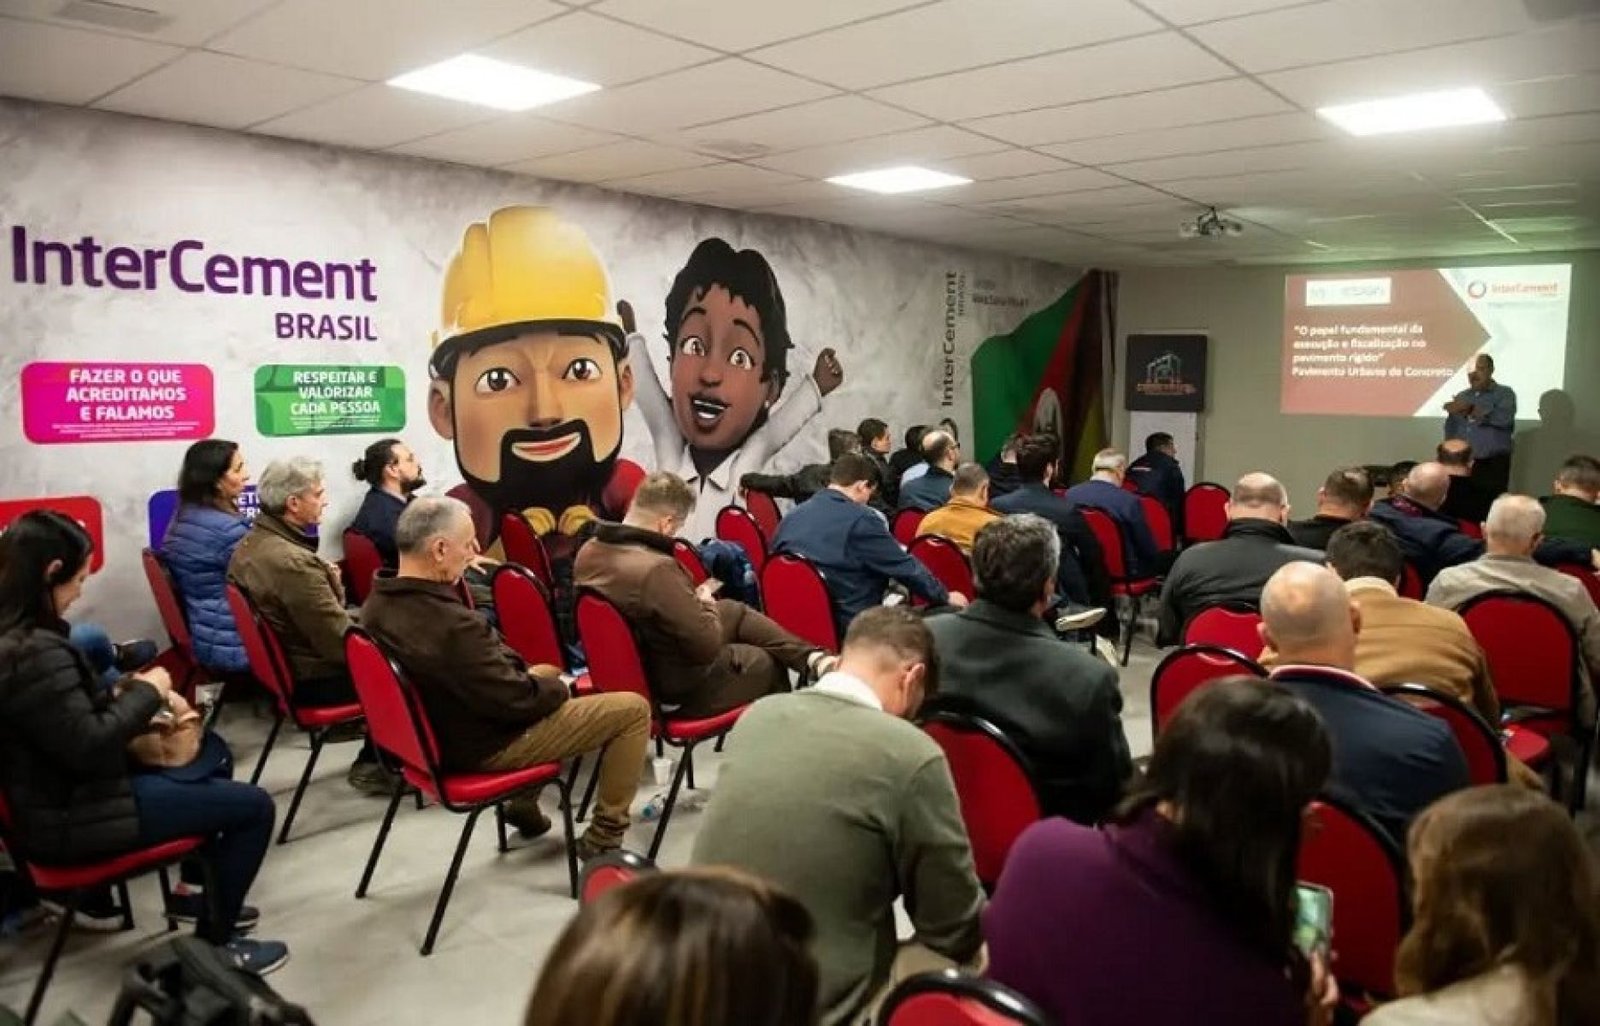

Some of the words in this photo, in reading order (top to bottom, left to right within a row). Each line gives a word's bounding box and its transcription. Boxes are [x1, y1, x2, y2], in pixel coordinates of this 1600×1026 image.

[12, 226, 378, 301] InterCement
[275, 312, 378, 341] BRASIL
[1310, 325, 1339, 336] papel
[1340, 324, 1407, 335] fundamental
[941, 271, 957, 406] InterCement
[1342, 341, 1350, 349] e
[1351, 337, 1410, 350] fiscalização
[1292, 353, 1347, 364] pavimento
[69, 368, 126, 383] FAZER
[131, 368, 143, 383] O
[148, 369, 182, 385] QUE
[294, 371, 365, 383] RESPEITAR
[369, 371, 377, 383] E
[1292, 366, 1346, 377] Pavimento
[66, 387, 187, 402] ACREDITAMOS
[299, 386, 373, 399] VALORIZAR
[80, 406, 92, 421] E
[96, 405, 175, 420] FALAMOS
[290, 403, 328, 415] CADA
[330, 400, 381, 414] PESSOA
